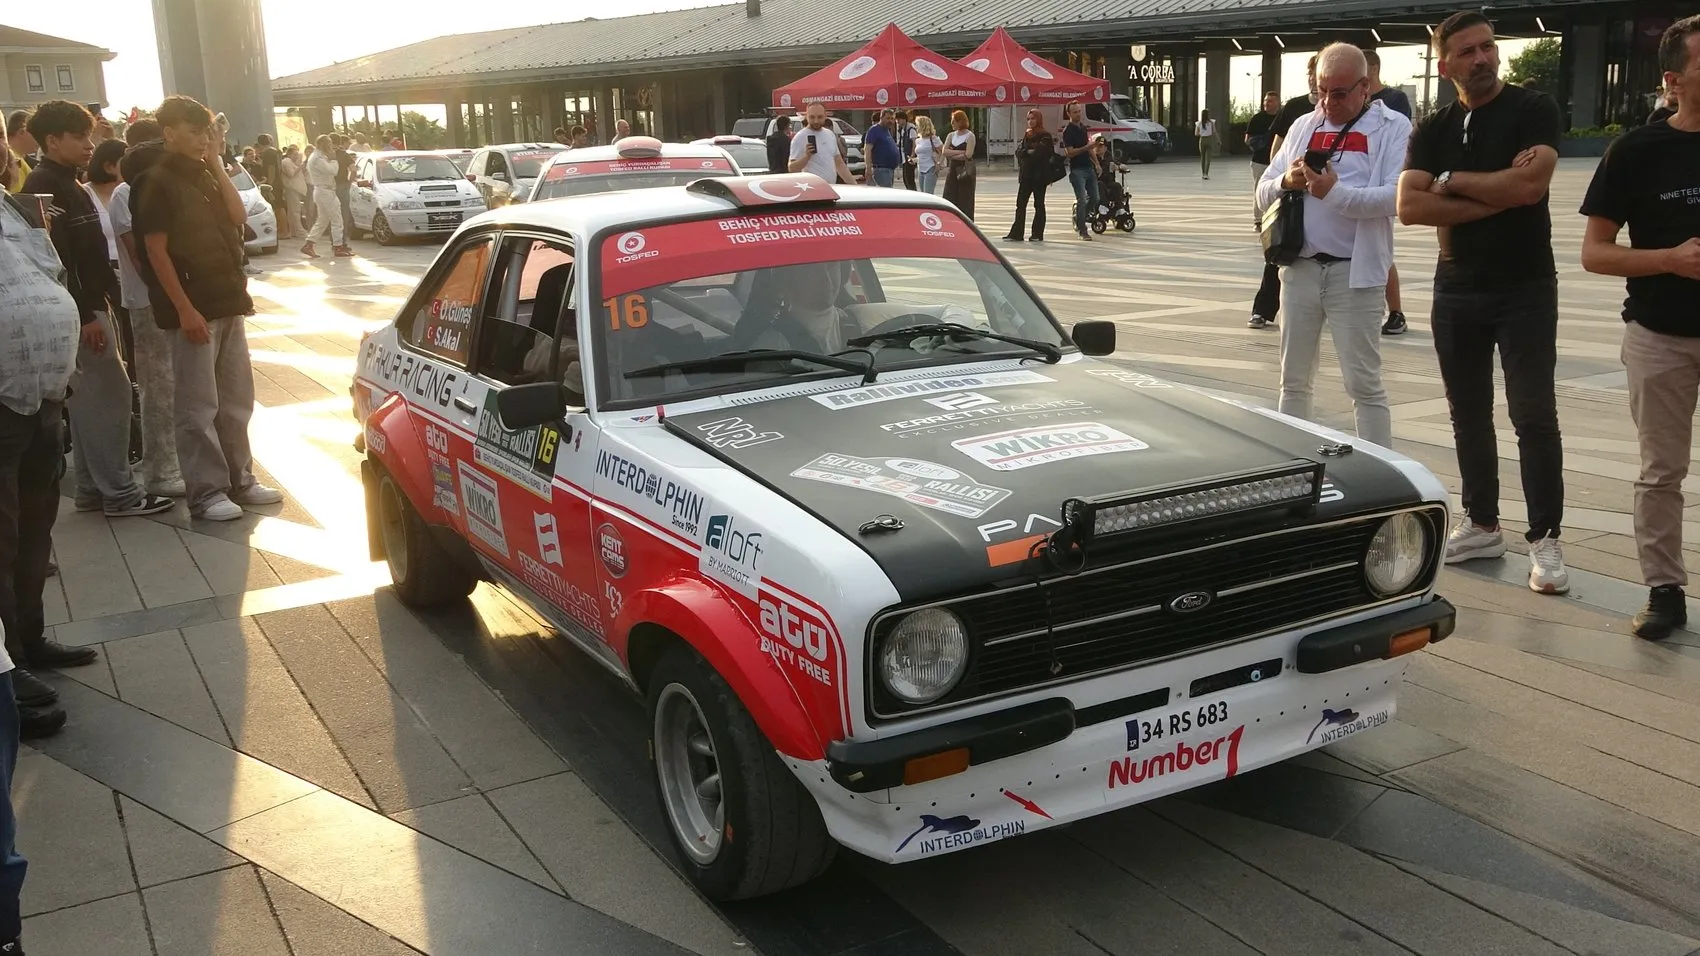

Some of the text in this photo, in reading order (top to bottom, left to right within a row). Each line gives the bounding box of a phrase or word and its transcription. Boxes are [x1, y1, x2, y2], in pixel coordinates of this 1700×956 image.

[1660, 187, 1700, 200] NINETEE
[718, 212, 856, 231] BEHİÇ YURDAÇALIŞAN
[727, 226, 863, 244] TOSFED RALLİ KUPASI
[921, 229, 955, 238] TOSFED
[615, 249, 660, 264] TOSFED
[603, 294, 649, 331] 16
[434, 326, 461, 351] S.Akal
[400, 357, 456, 407] RACING
[538, 428, 557, 464] 16
[596, 450, 703, 525] INTERDOLPHIN
[672, 515, 698, 536] Since 1992
[706, 515, 763, 570] aloft
[708, 556, 749, 586] BY MARRIOTT
[760, 636, 831, 686] DUTY FREE
[1142, 701, 1228, 743] 34 RS 683
[1321, 710, 1388, 743] INTERDOLPHIN
[920, 820, 1025, 853] INTERDOLPHIN
